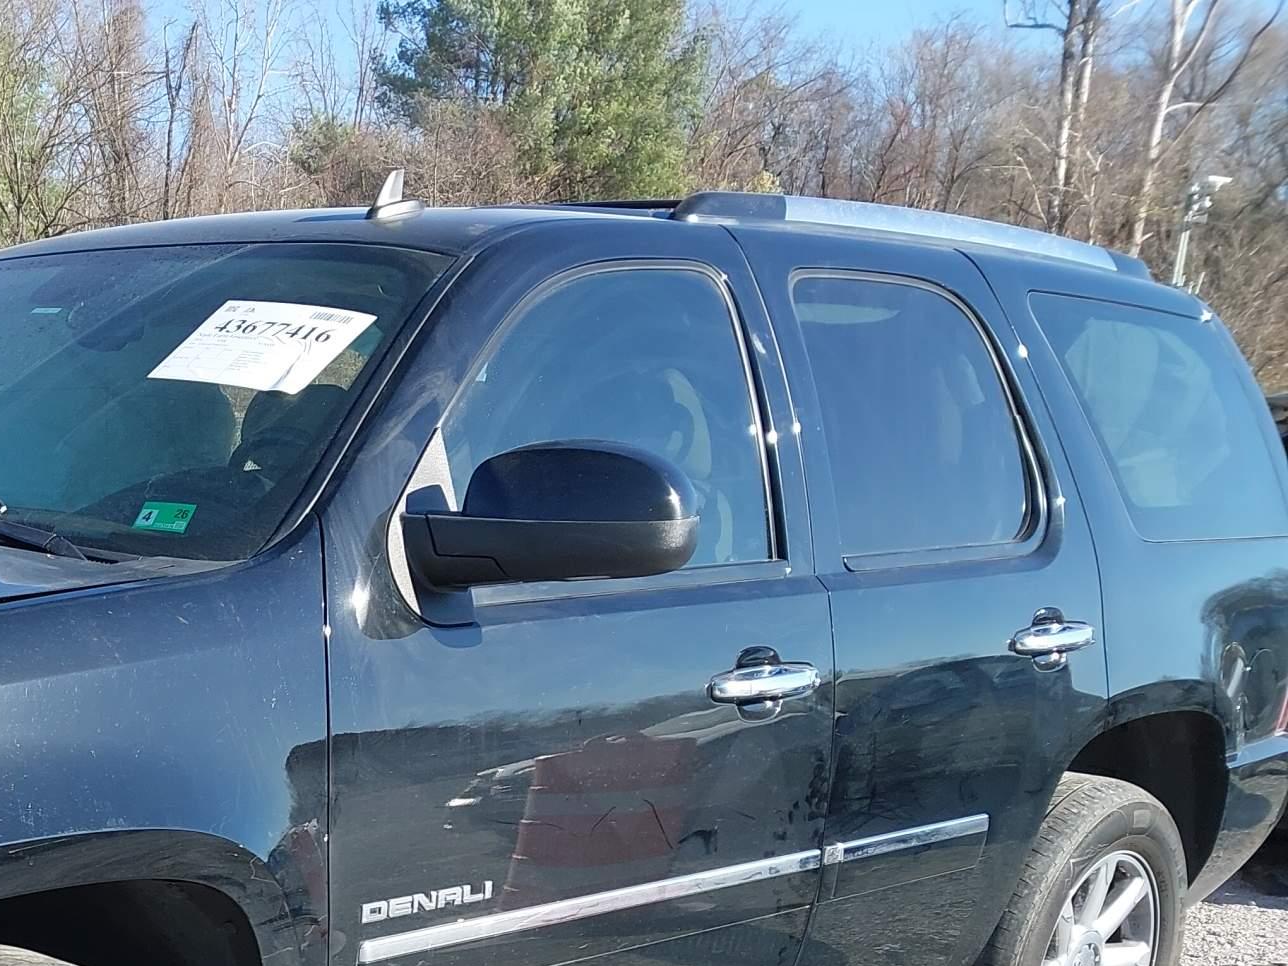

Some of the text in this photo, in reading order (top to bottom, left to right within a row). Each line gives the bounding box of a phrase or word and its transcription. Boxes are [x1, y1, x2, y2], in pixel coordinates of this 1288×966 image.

[214, 318, 336, 344] 43677416
[142, 511, 153, 522] 4
[174, 508, 190, 519] 26
[360, 880, 494, 924] DENALI
